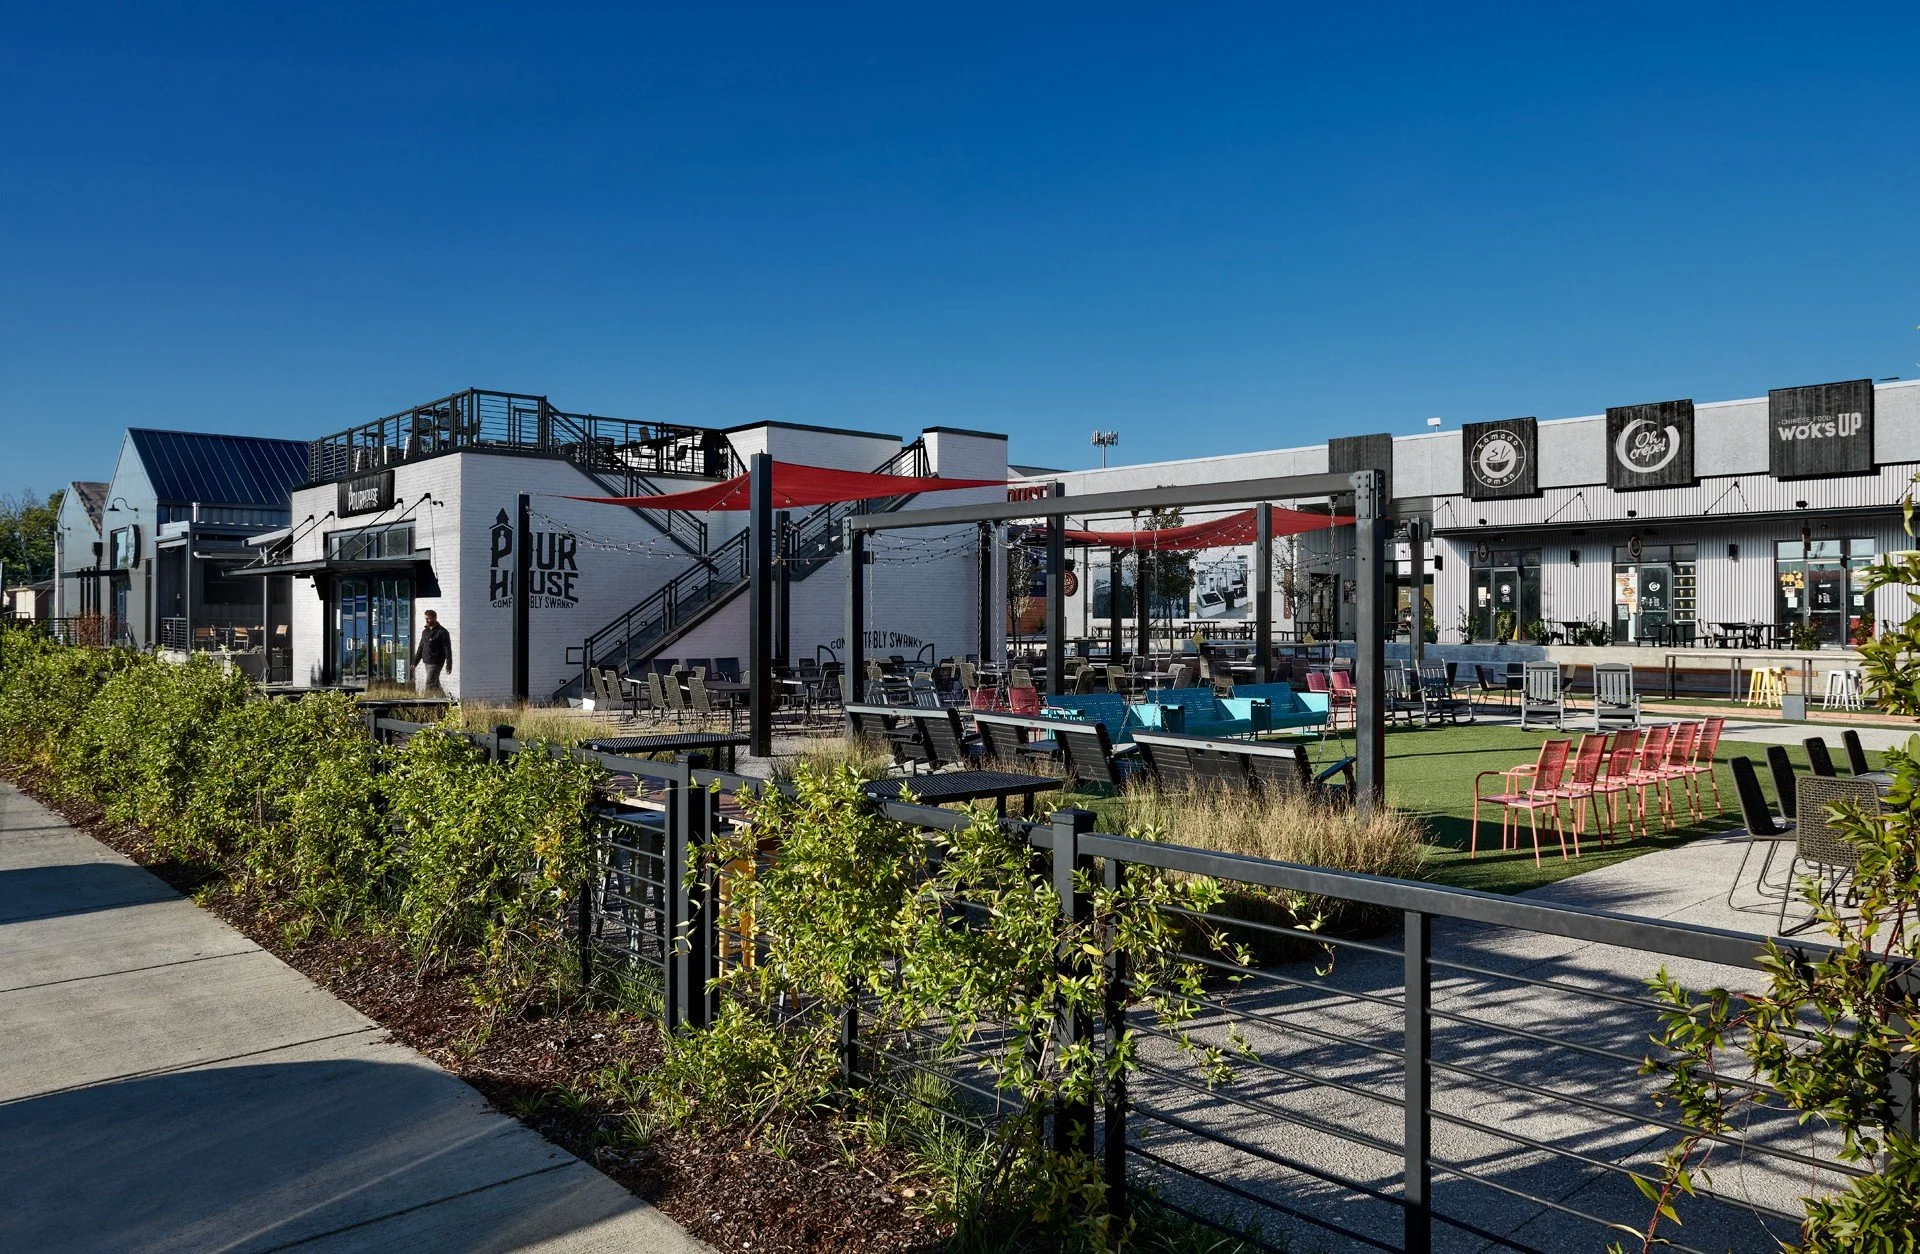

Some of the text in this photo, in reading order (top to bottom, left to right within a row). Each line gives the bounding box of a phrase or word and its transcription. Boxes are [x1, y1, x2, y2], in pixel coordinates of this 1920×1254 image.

[1778, 412, 1862, 441] WOK'S UP
[1781, 414, 1831, 425] CHINESE FOOD
[1477, 433, 1519, 450] kamado
[1635, 431, 1661, 448] Oh
[1481, 473, 1515, 485] ramen
[489, 524, 577, 571] PUR
[489, 570, 579, 603] HUSE
[544, 596, 575, 609] SWANKY
[889, 632, 923, 648] SWANKY
